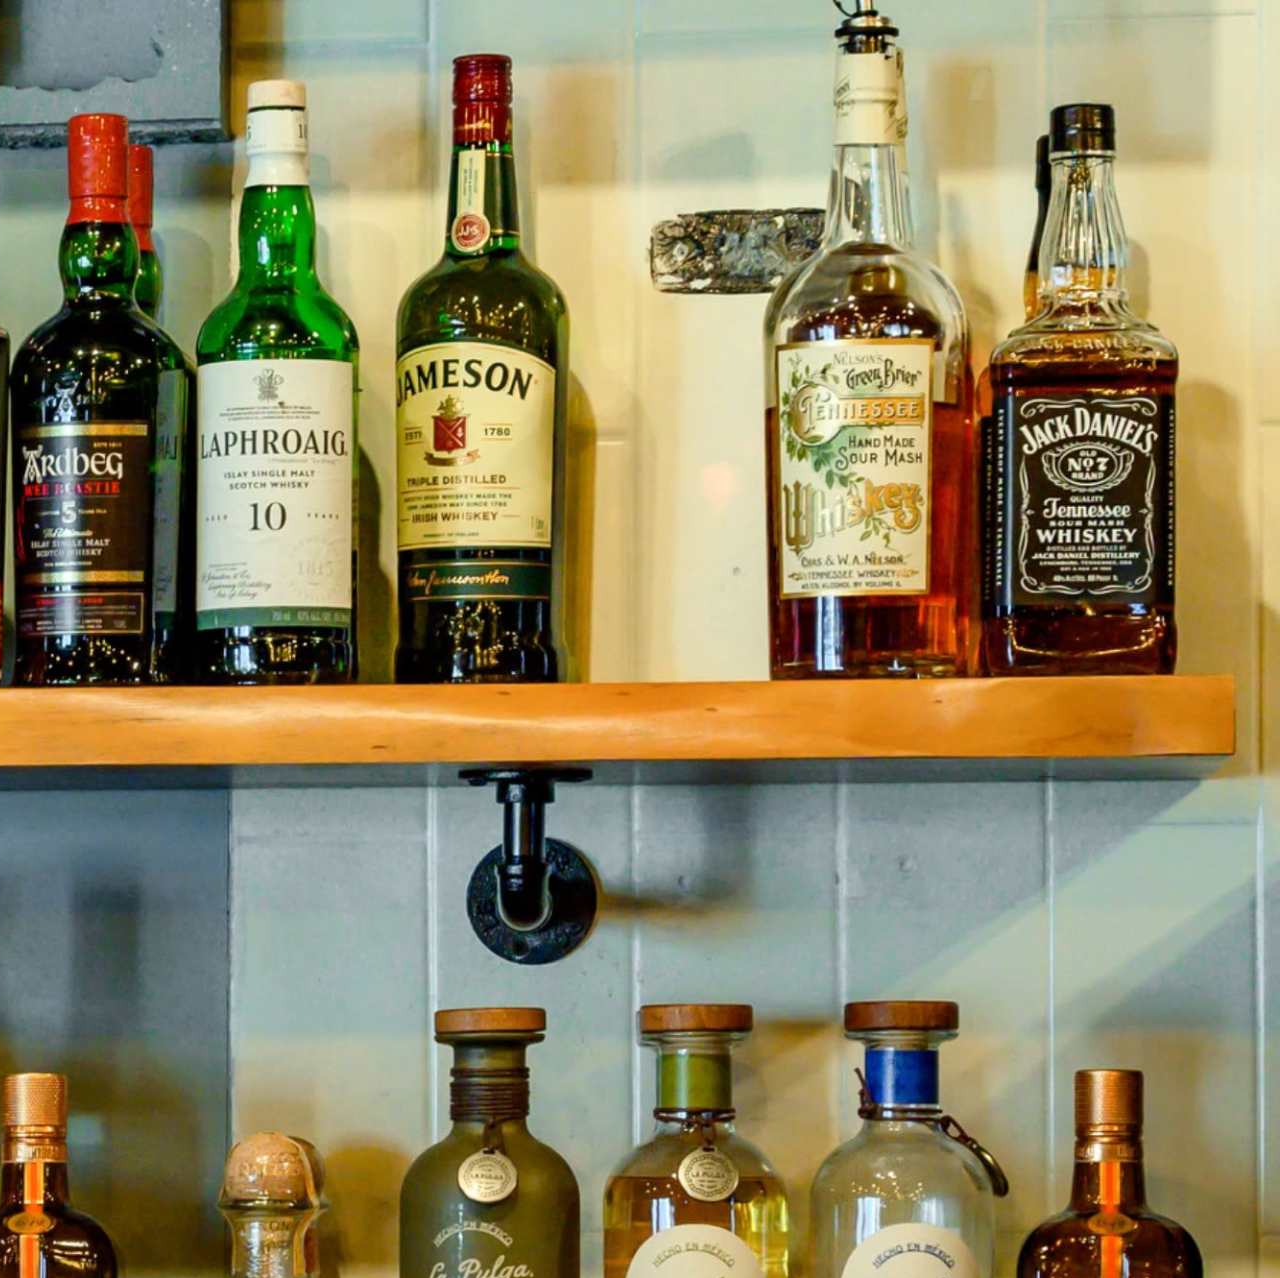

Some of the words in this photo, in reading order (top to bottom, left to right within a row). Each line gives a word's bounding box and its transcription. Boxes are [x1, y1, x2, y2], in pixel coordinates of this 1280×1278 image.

[397, 356, 533, 409] JAMESON
[788, 385, 921, 437] TENNESSEE
[1018, 413, 1072, 456] JACK
[1073, 405, 1159, 457] DANIEL'S
[200, 427, 346, 459] LAPHROAIG
[848, 434, 882, 449] HAND
[883, 433, 915, 448] MADE
[835, 446, 880, 471] SOUR
[883, 446, 923, 466] MASH
[1079, 449, 1097, 459] OLD
[1094, 456, 1109, 472] 7
[223, 470, 249, 479] ISLAY
[251, 469, 288, 478] SINGLE
[290, 469, 315, 478] MALT
[406, 475, 439, 487] TRIPLE
[442, 474, 507, 485] DISTILLED
[1070, 471, 1104, 481] BRAND
[228, 482, 268, 490] SCOTCH
[270, 481, 310, 490] WHISKY
[1069, 495, 1105, 503] QUALITY
[60, 500, 78, 526] 5
[1042, 496, 1132, 519] Tennessee
[248, 501, 287, 532] 10
[411, 511, 438, 524] IRISH
[441, 510, 499, 522] WHISKEY
[782, 477, 925, 556] Whiskey
[1048, 519, 1083, 527] SOUR
[1087, 519, 1125, 527] MASH
[85, 537, 111, 548] MALT
[1035, 527, 1138, 544] WHISKEY
[685, 1241, 700, 1253] EN
[906, 1242, 921, 1253] EN
